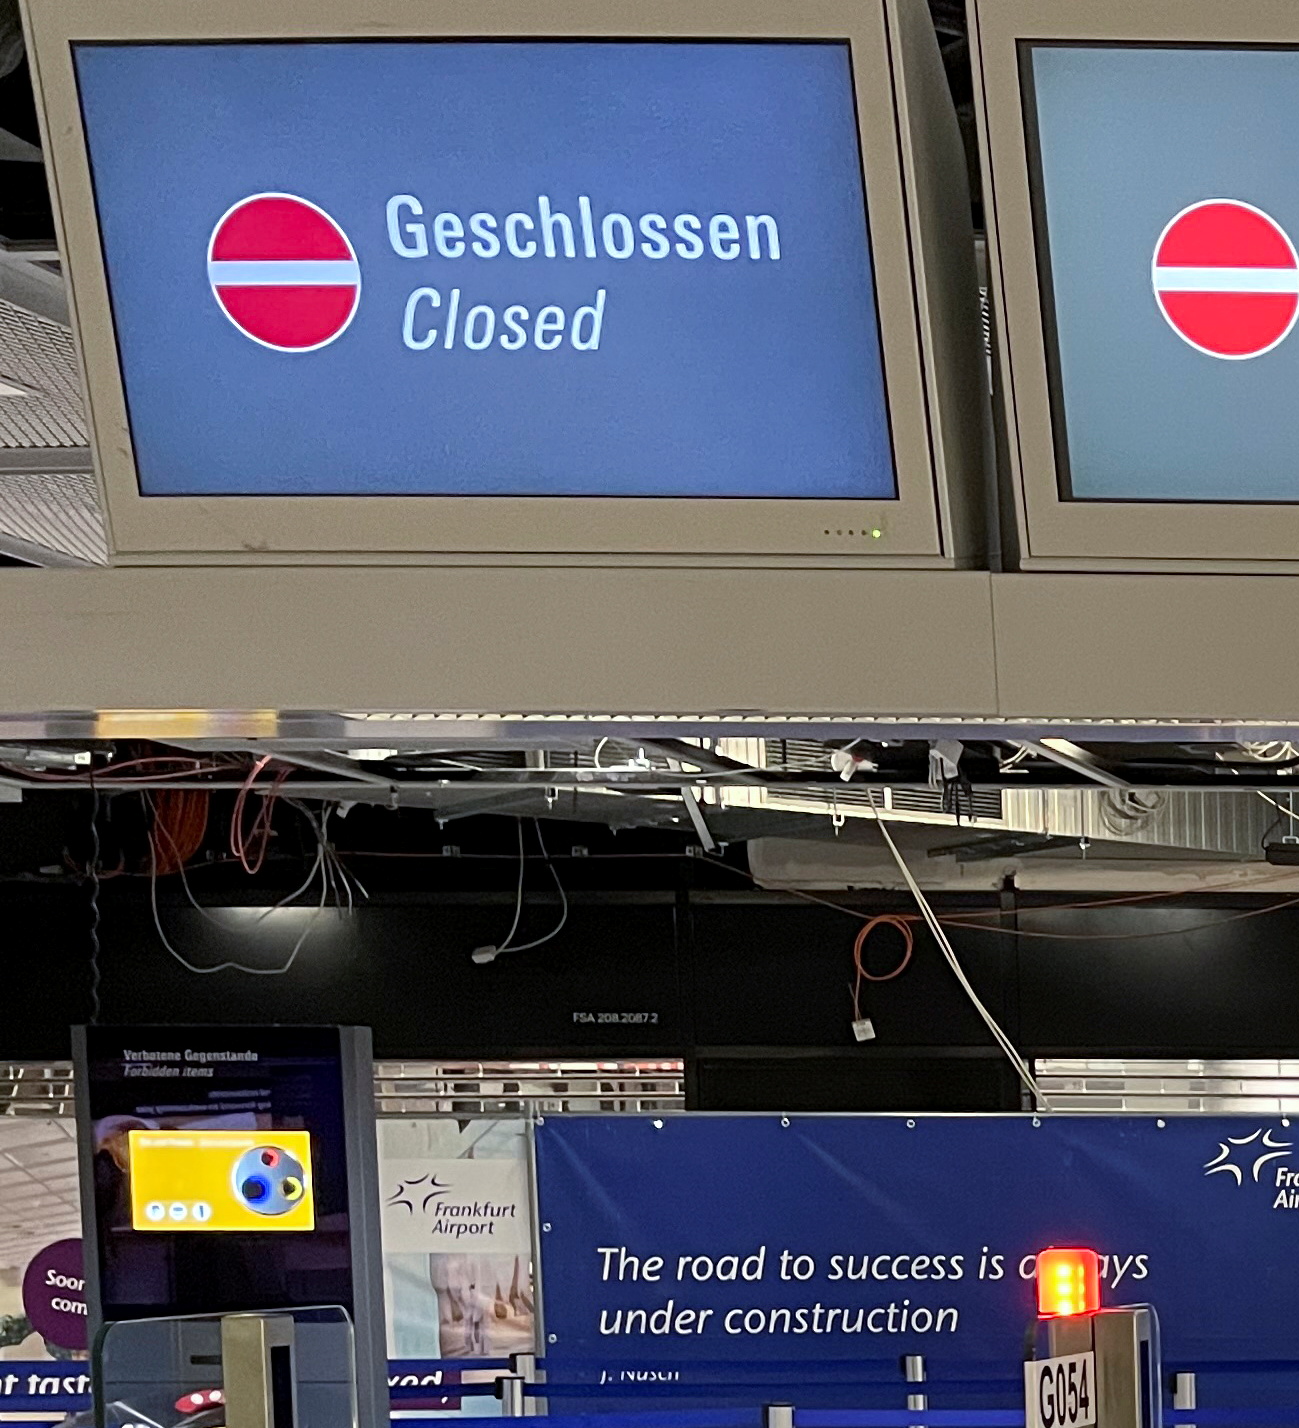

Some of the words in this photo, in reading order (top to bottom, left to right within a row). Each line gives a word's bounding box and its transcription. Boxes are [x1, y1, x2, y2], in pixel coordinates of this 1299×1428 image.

[385, 195, 781, 261] Geschlossen
[401, 287, 607, 351] Closed
[573, 1012, 595, 1023] FSA
[434, 1201, 516, 1218] Frankfurt
[431, 1218, 494, 1239] Airport
[597, 1246, 664, 1281] The
[676, 1245, 766, 1281] road
[780, 1250, 815, 1280] to
[827, 1254, 964, 1281] success
[978, 1246, 1004, 1280] is
[600, 1299, 714, 1335] under
[724, 1299, 959, 1335] construction
